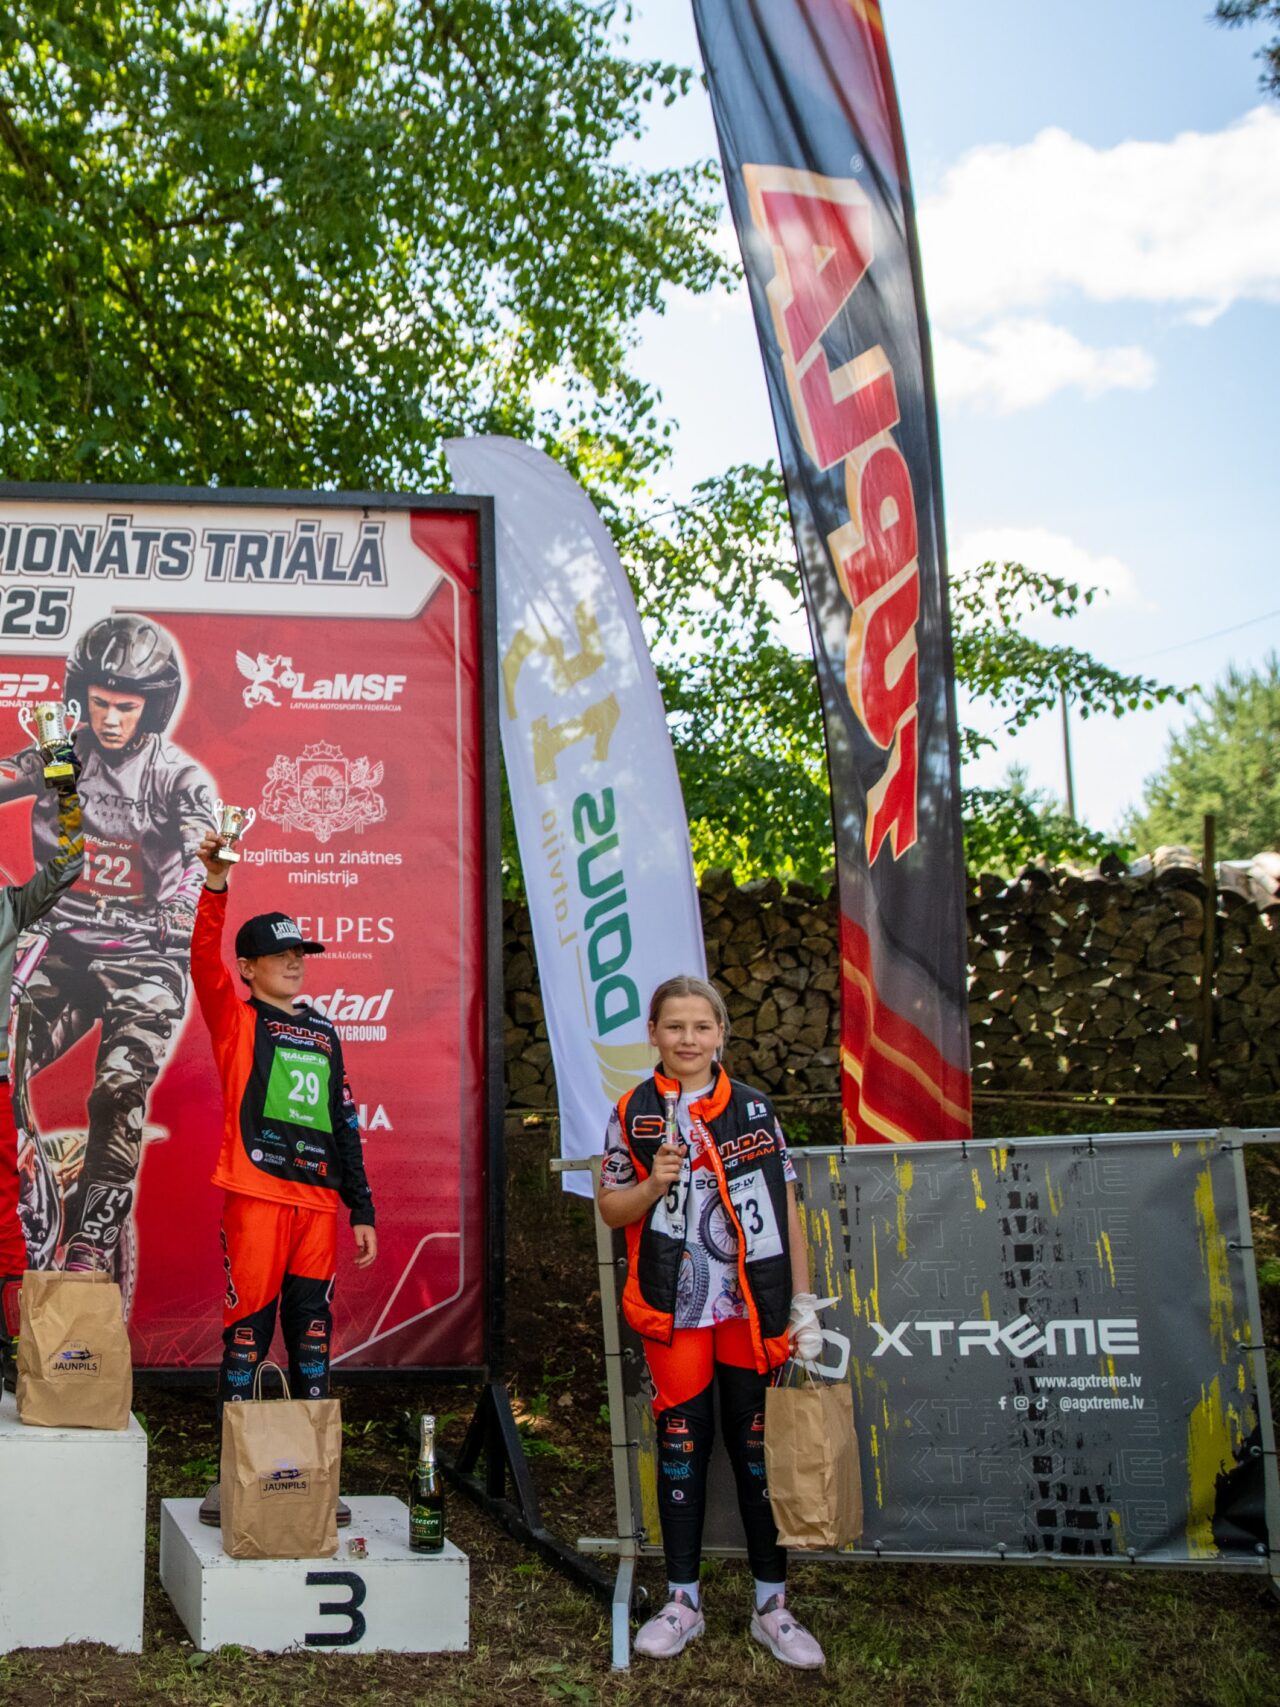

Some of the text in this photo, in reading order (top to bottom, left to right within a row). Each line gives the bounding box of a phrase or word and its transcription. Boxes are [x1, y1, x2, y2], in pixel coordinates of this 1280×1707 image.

[202, 518, 388, 587] TRIĀLĀ
[292, 672, 407, 702] LaMSF
[243, 848, 402, 867] Izglītības un zinātnes
[288, 870, 359, 887] ministrija
[287, 1069, 320, 1106] 29
[738, 1145, 776, 1163] TEAM
[869, 1314, 1141, 1359] XTREME
[52, 1359, 98, 1373] JAUNPILS
[1035, 1373, 1142, 1390] www.agxtreme.lv
[1059, 1394, 1145, 1413] @agxtreme.lv
[262, 1480, 308, 1493] JAUNPILS
[304, 1571, 367, 1647] 3
